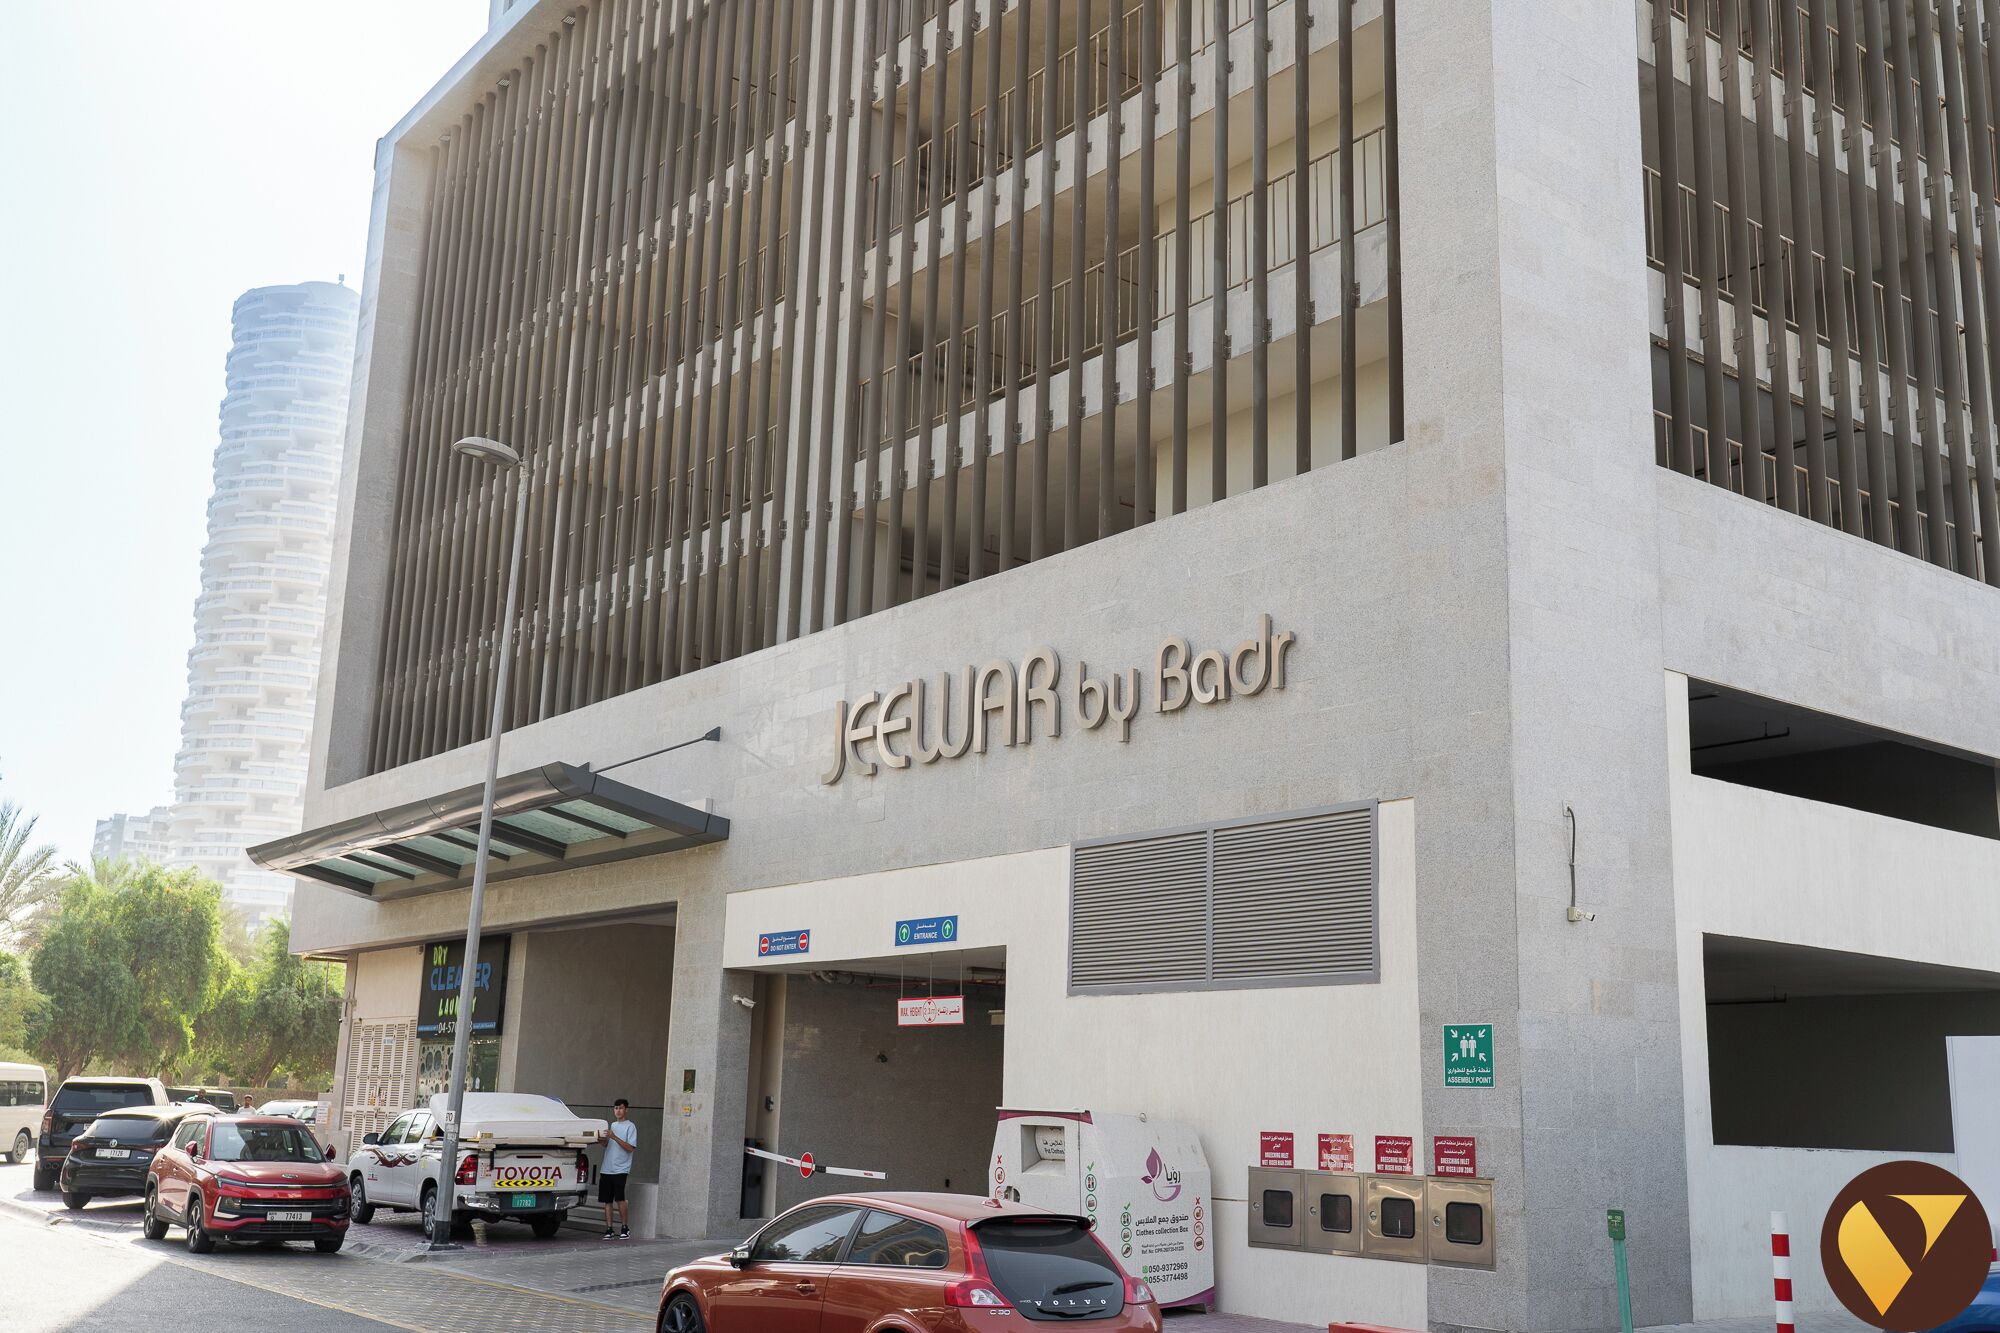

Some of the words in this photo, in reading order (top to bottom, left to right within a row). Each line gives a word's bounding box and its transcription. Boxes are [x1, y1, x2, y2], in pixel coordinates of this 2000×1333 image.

[821, 645, 1060, 785] JEEWAR
[1073, 661, 1139, 742] by
[1154, 613, 1295, 713] Badr
[914, 932, 938, 940] ENTRANCE
[433, 945, 448, 966] DRY
[430, 962, 492, 992] CLEAER
[494, 1166, 562, 1180] TOYOTA
[1164, 1163, 1181, 1183] رؤيا
[1135, 1215, 1156, 1226] الملابس
[1158, 1216, 1169, 1225] جمع
[1170, 1214, 1189, 1224] صندوق
[1136, 1228, 1154, 1236] Clothes
[1155, 1227, 1179, 1235] collection
[1148, 1262, 1188, 1273] 050-9372969
[1148, 1273, 1188, 1284] 055-3774498
[1034, 1299, 1106, 1307] VOLVO
